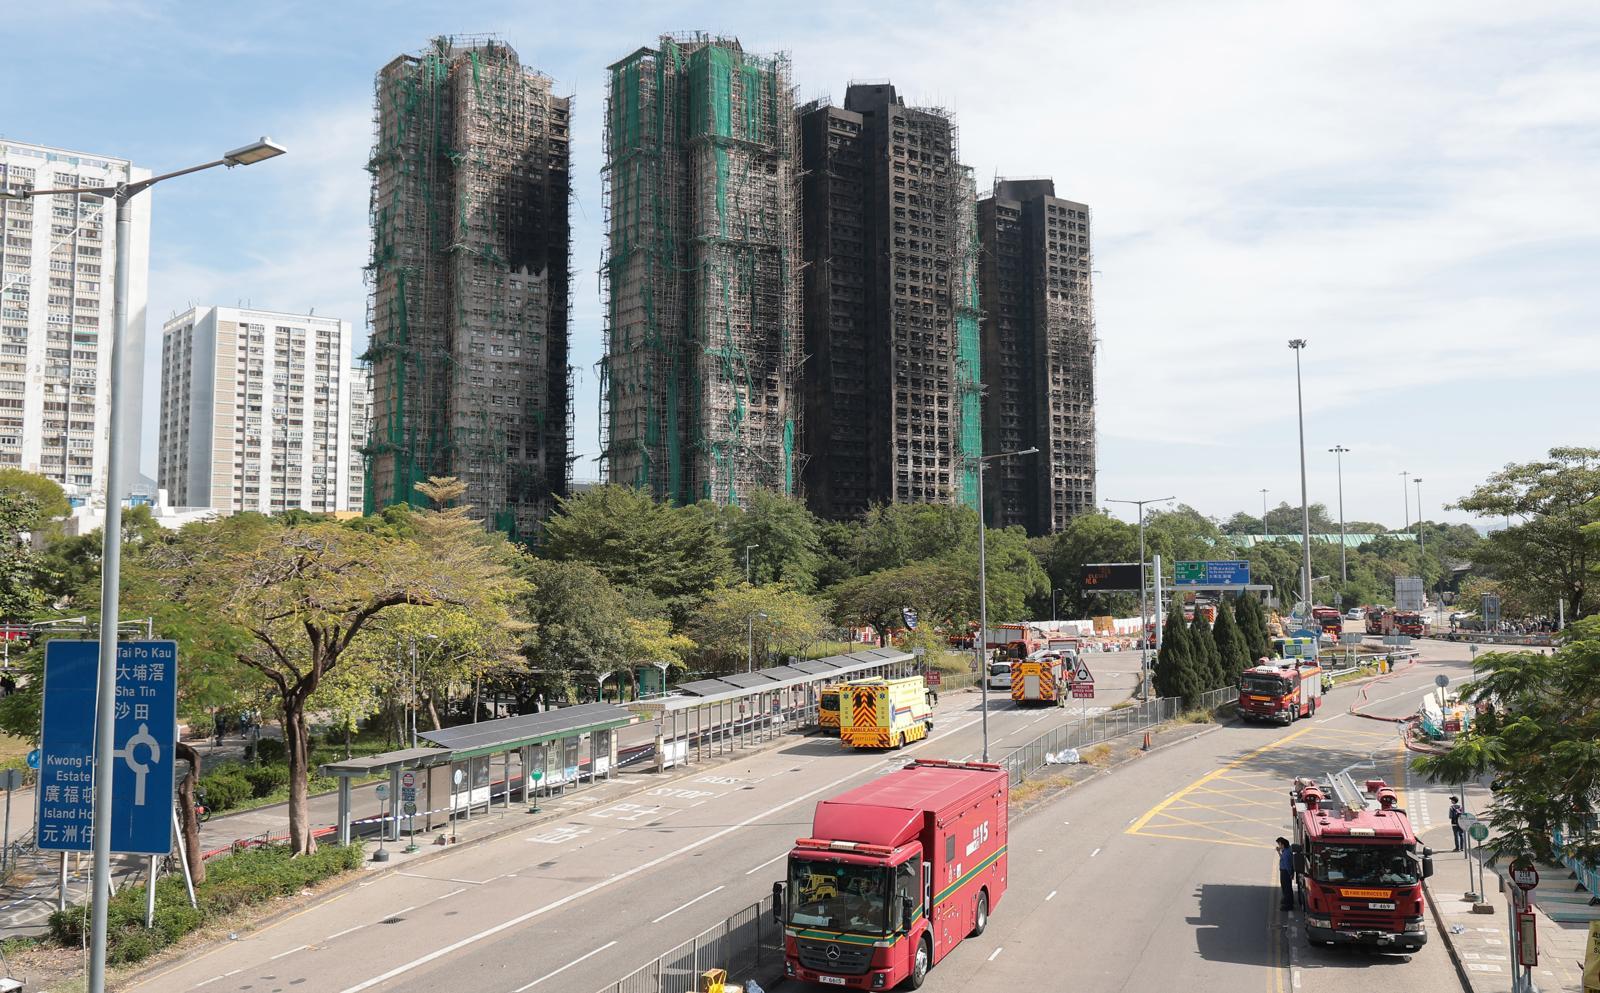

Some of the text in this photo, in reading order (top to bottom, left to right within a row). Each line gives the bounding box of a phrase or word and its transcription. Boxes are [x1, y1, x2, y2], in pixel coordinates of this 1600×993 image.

[117, 648, 172, 658] Tai Po Kau
[116, 663, 164, 681] 大埔滘
[115, 685, 156, 697] Sha Tin
[115, 702, 149, 720] 沙田
[47, 755, 98, 768] Kwong Fu
[56, 770, 91, 782] Estate
[646, 788, 714, 799] STOP
[43, 807, 97, 820] Island Ho
[42, 824, 96, 843] 元洲仔
